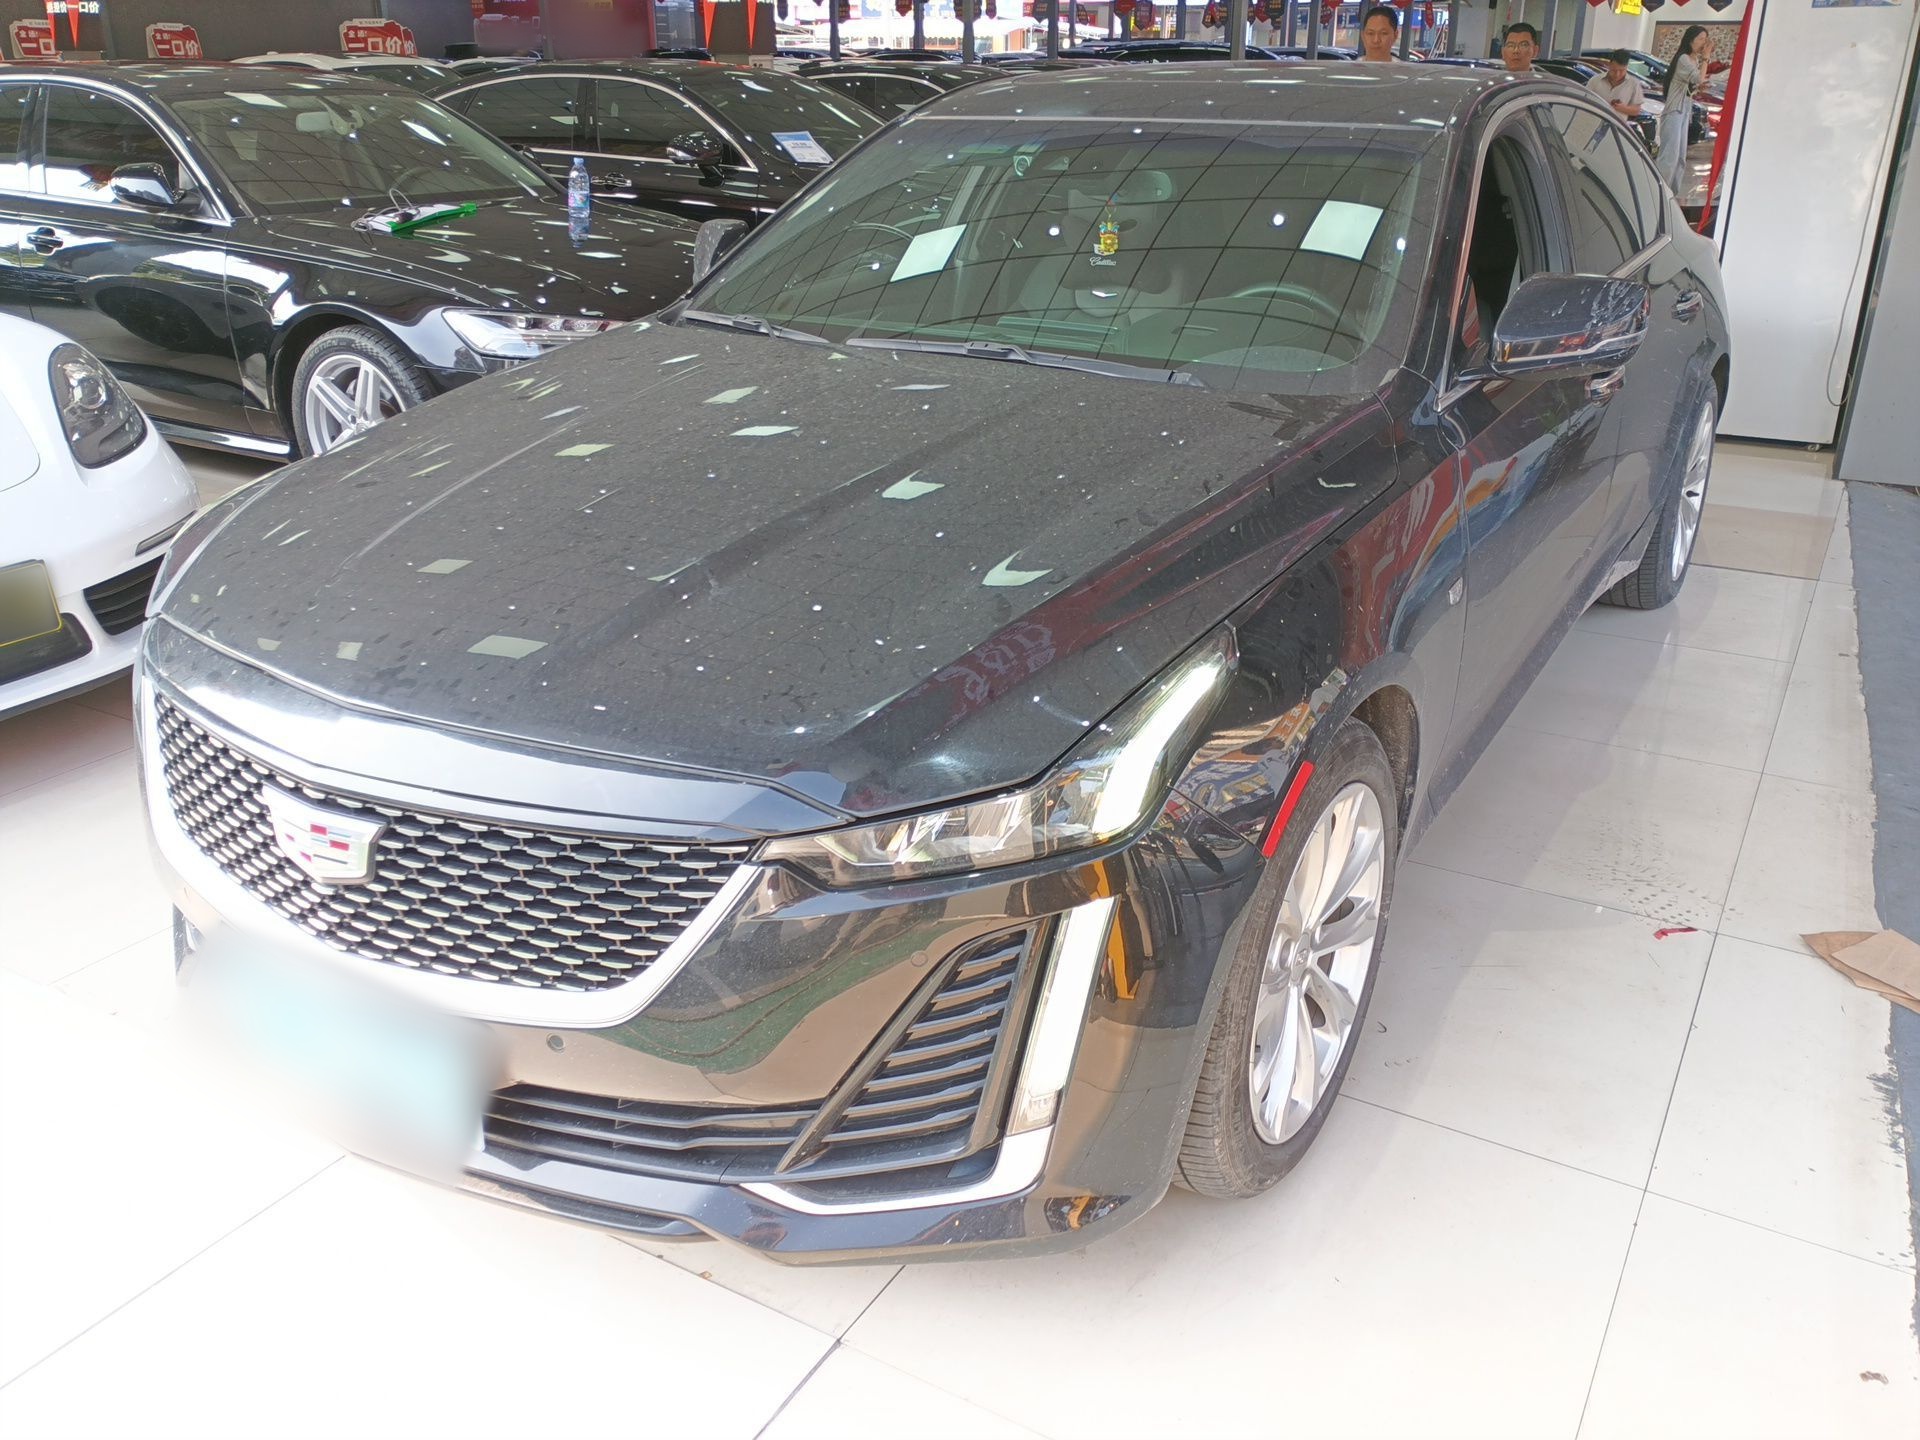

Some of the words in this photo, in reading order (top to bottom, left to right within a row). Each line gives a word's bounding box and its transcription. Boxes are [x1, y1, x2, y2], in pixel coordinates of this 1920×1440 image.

[156, 40, 199, 56] 一口价
[347, 36, 402, 54] 一口价
